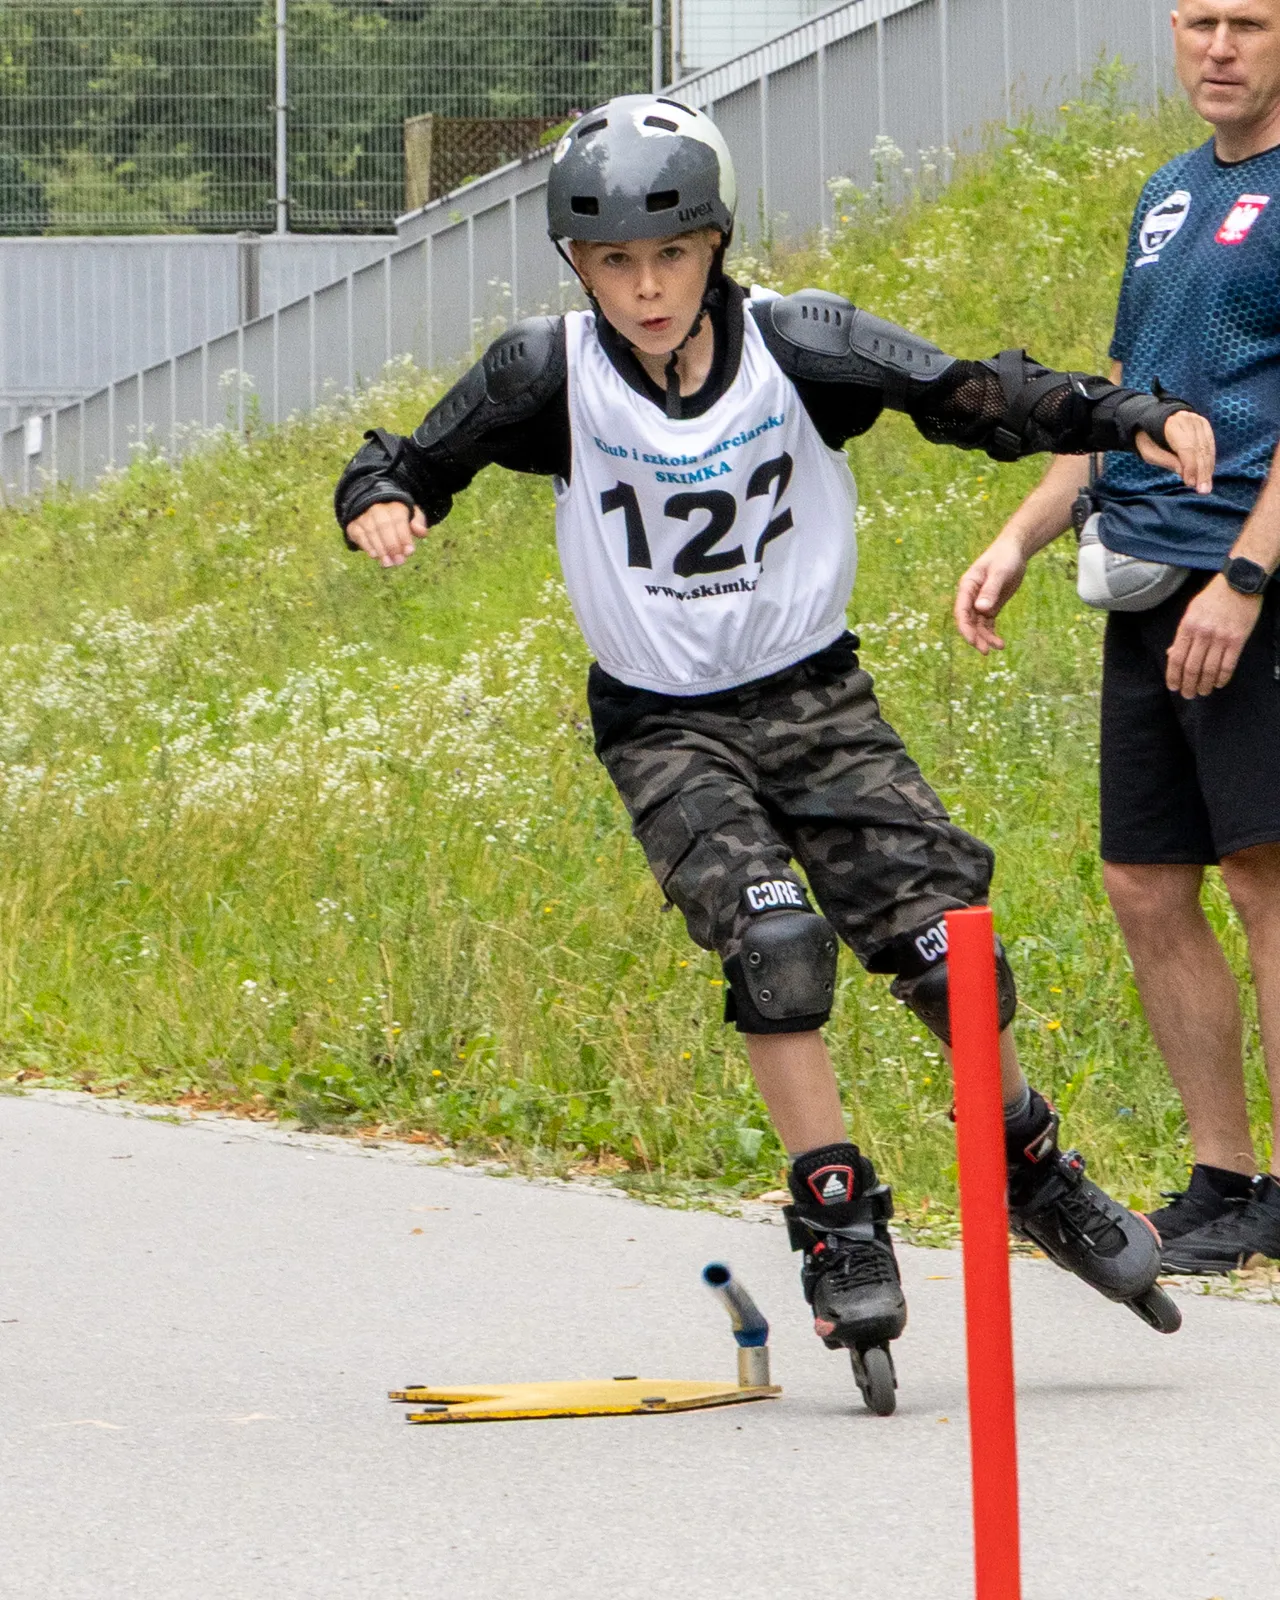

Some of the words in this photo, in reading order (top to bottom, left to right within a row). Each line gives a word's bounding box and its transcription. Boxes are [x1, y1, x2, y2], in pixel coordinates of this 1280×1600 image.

[678, 201, 714, 222] uvex
[593, 436, 628, 458] Klub
[632, 448, 639, 461] i
[655, 461, 732, 484] SKIMKA
[600, 451, 794, 578] 122
[746, 880, 803, 910] CORE
[914, 920, 949, 962] CO
